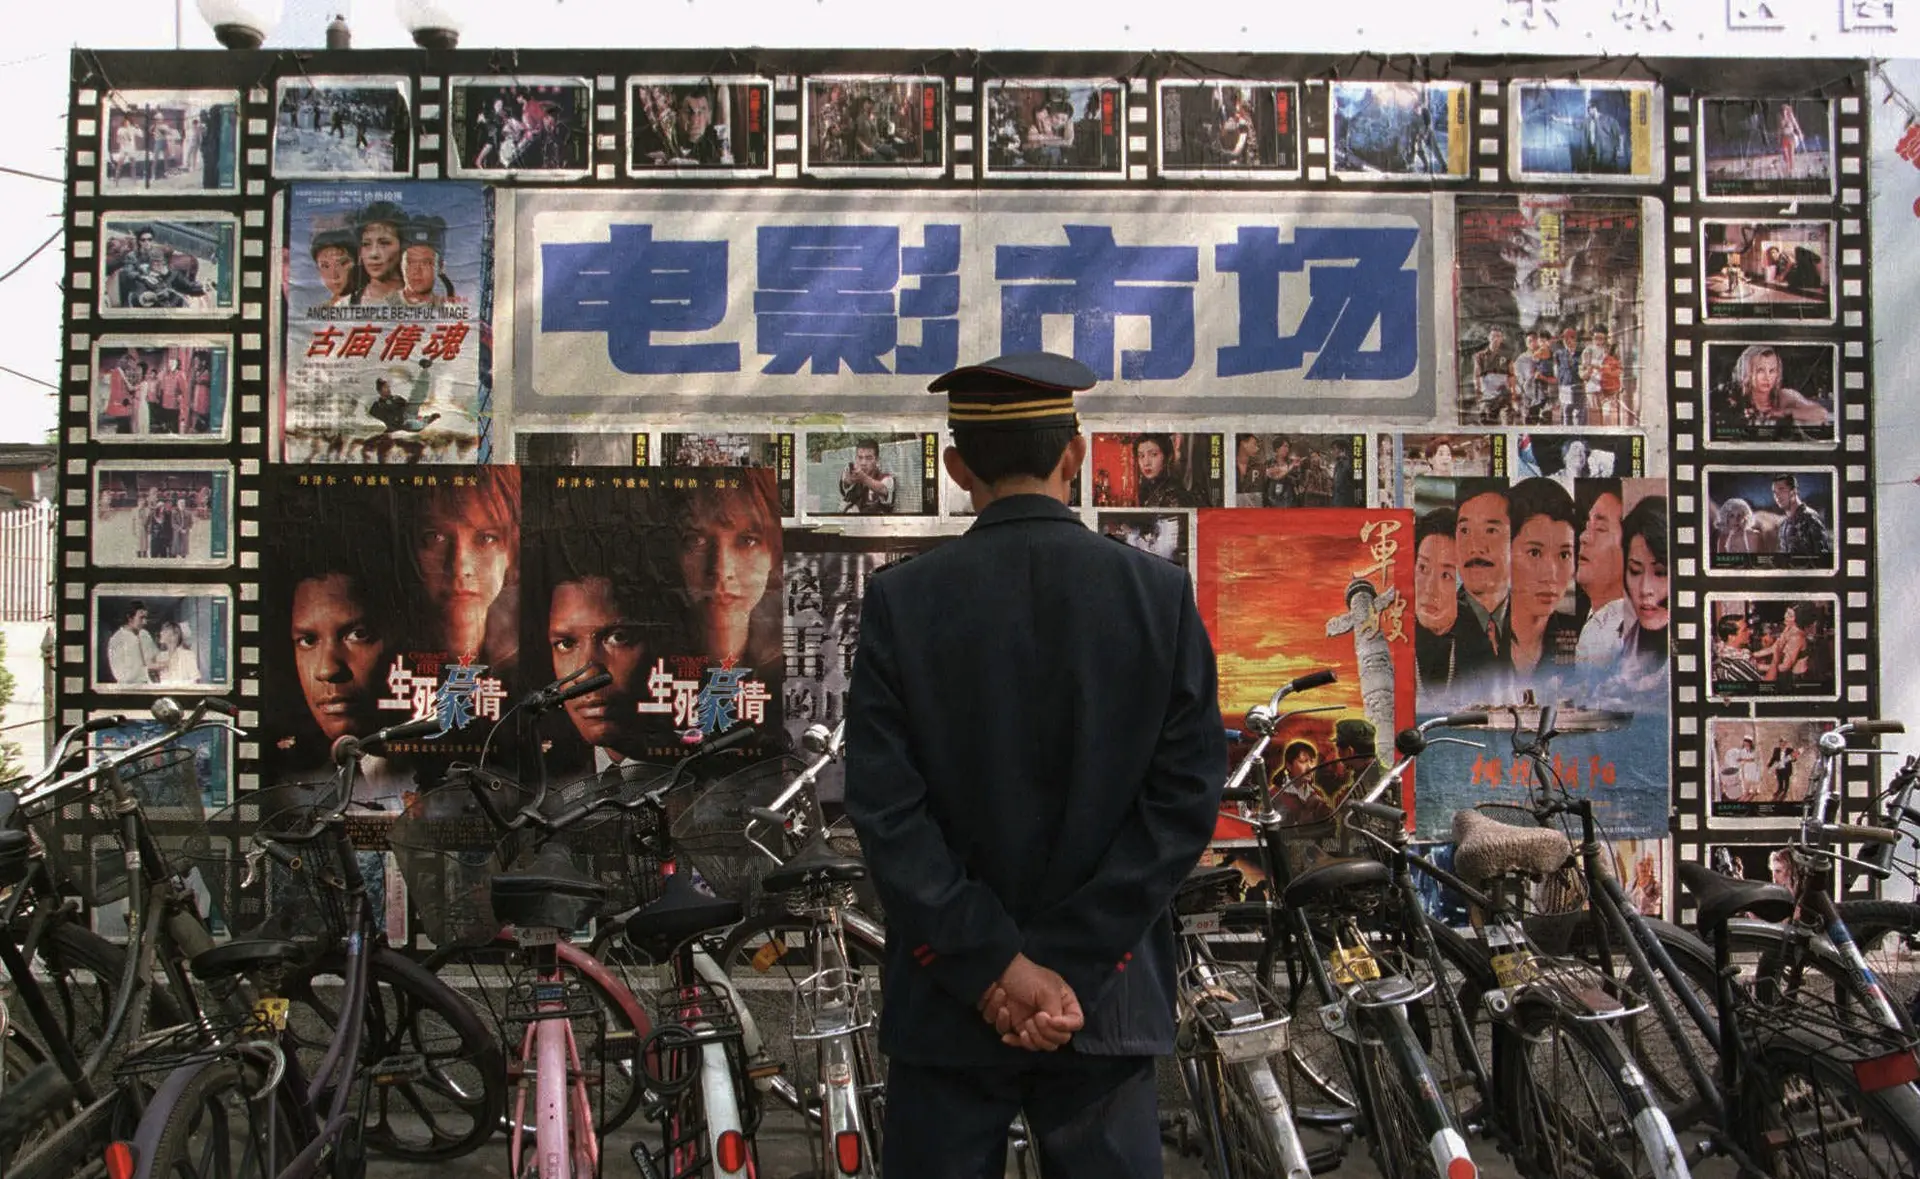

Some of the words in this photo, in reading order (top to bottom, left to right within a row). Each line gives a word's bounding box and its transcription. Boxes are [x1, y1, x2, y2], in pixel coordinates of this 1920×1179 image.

[306, 320, 470, 362] 古庙倩魂
[307, 307, 349, 319] ANCIENT
[350, 307, 388, 319] TEMPLE
[438, 307, 469, 319] IMAGE
[541, 223, 1420, 382] 电影市场
[377, 652, 508, 732] 生死豪情
[637, 654, 772, 734] 生死豪情
